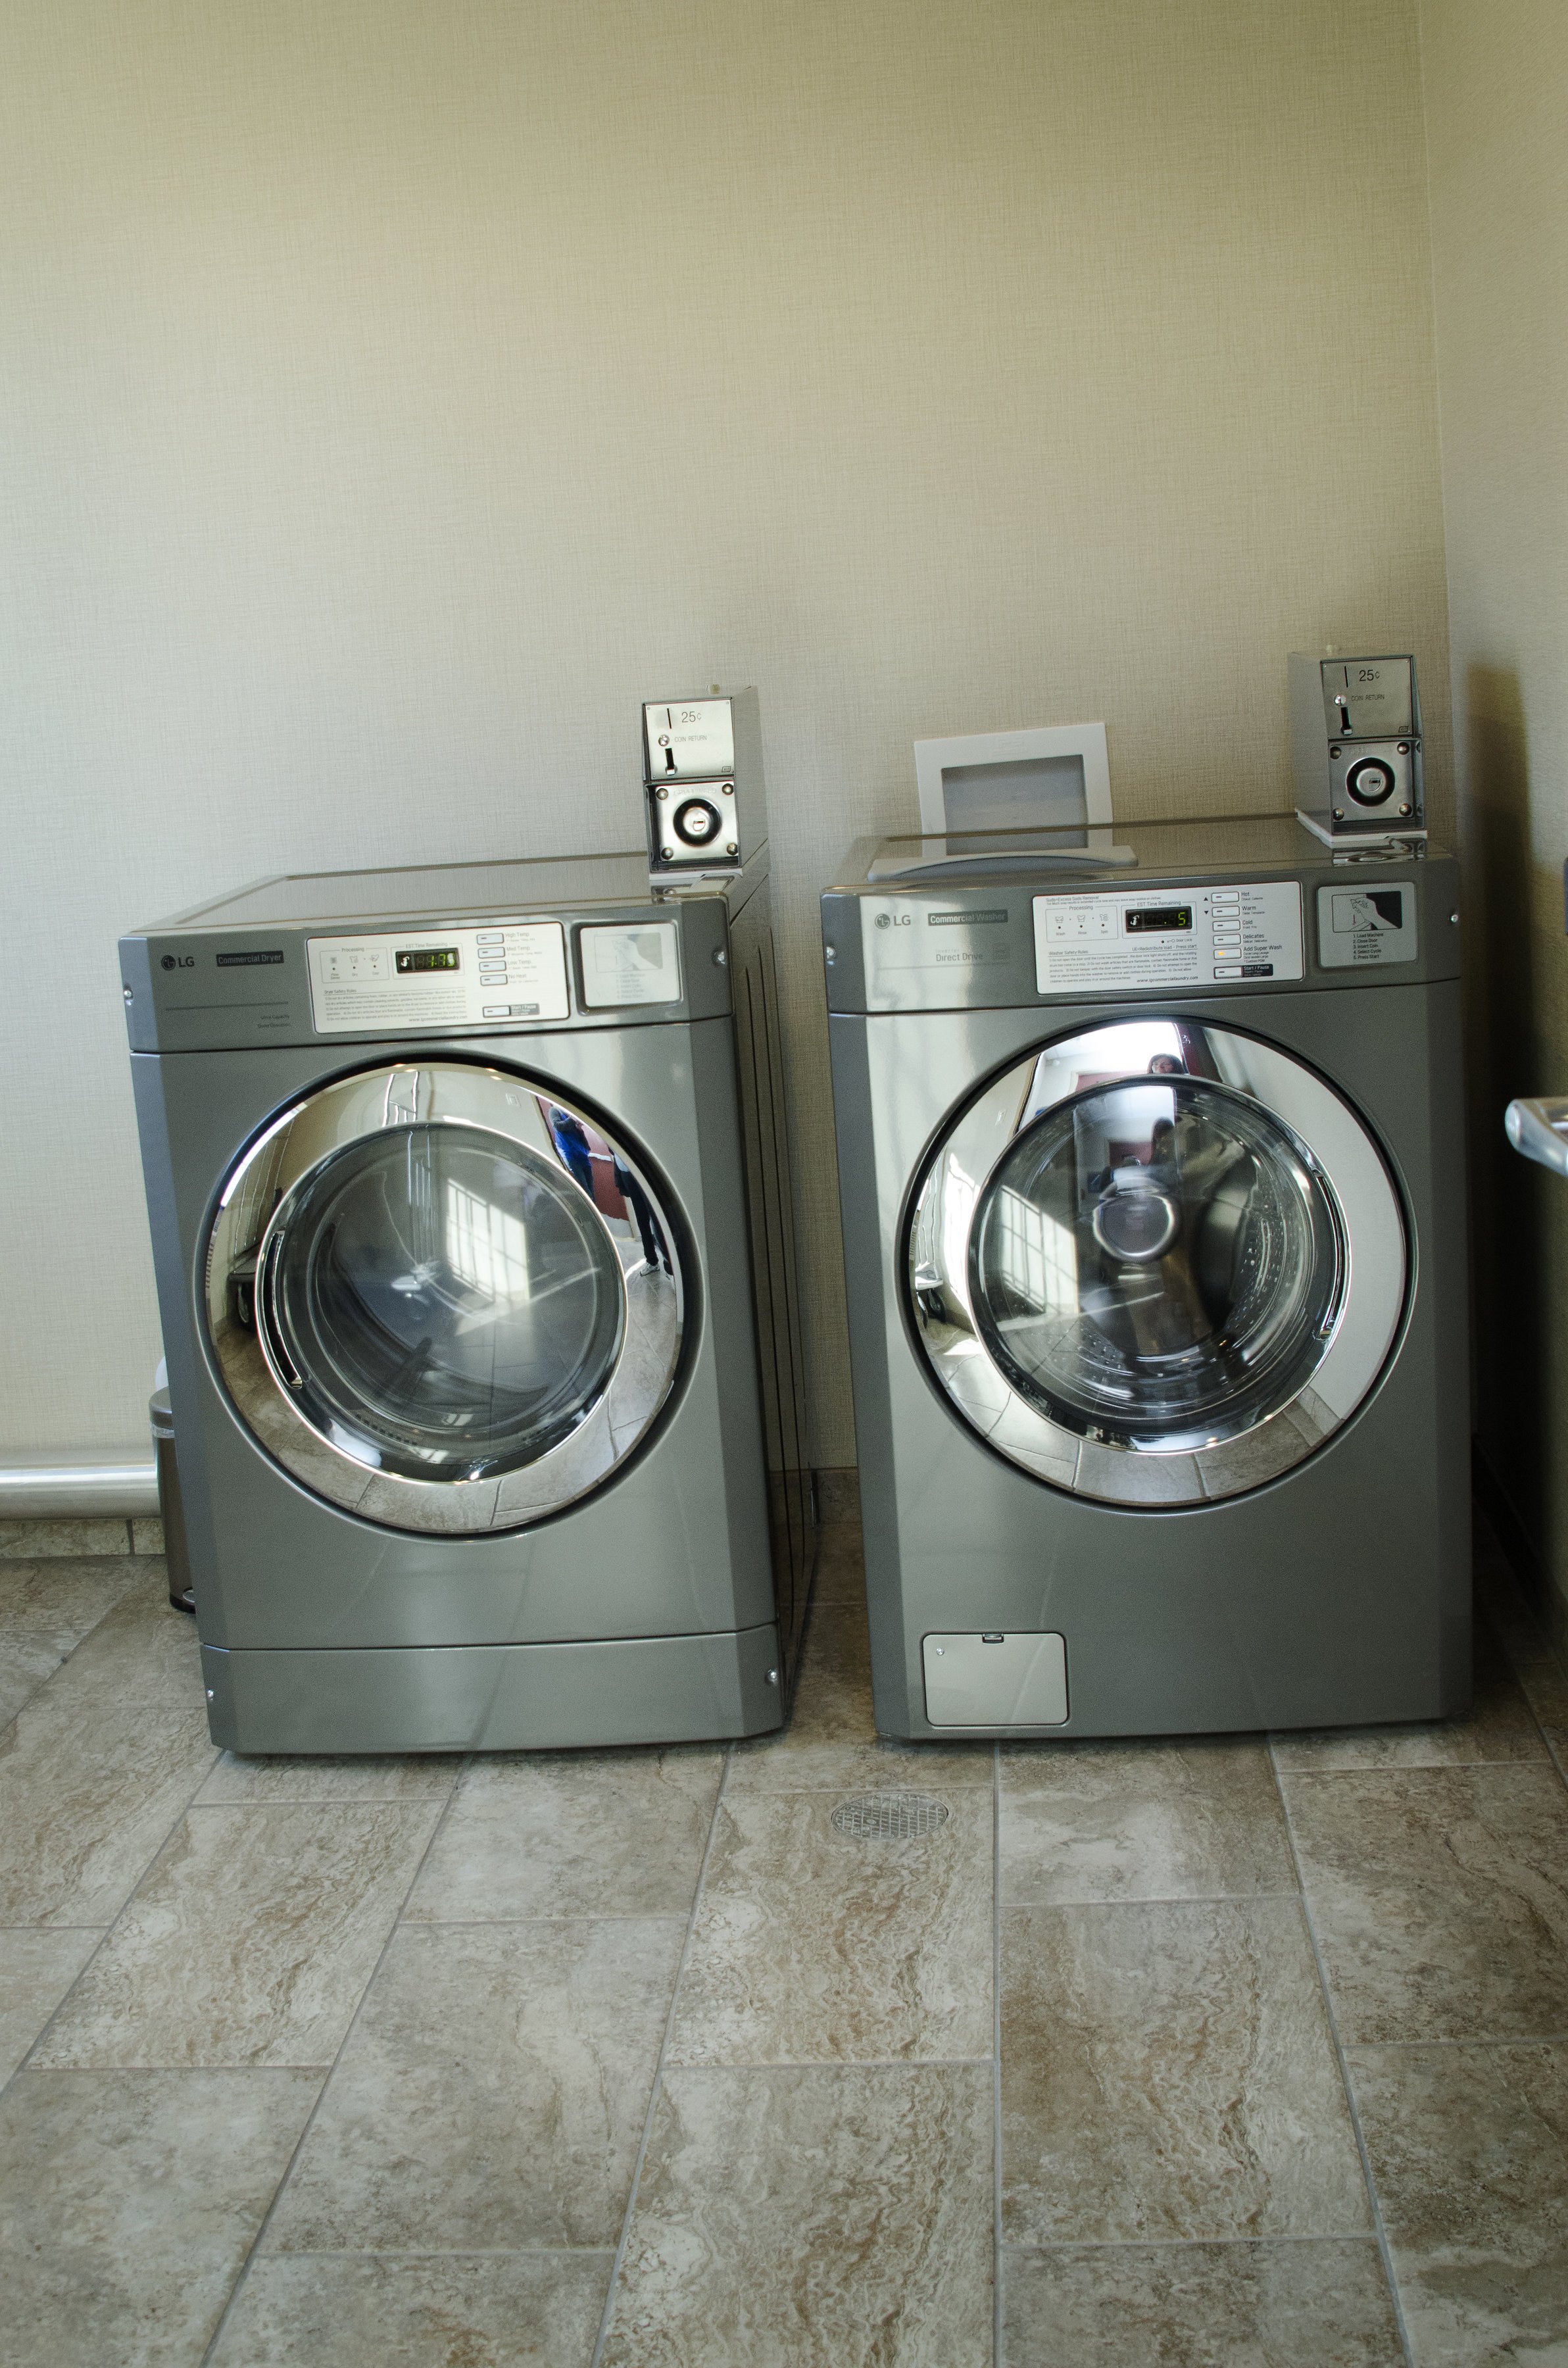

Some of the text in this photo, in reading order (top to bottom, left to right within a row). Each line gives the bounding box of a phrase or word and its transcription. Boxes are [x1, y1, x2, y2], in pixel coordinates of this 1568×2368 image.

[893, 915, 911, 926] LG
[930, 914, 975, 924] Commercial
[178, 954, 282, 968] LG Commercial Dryer
